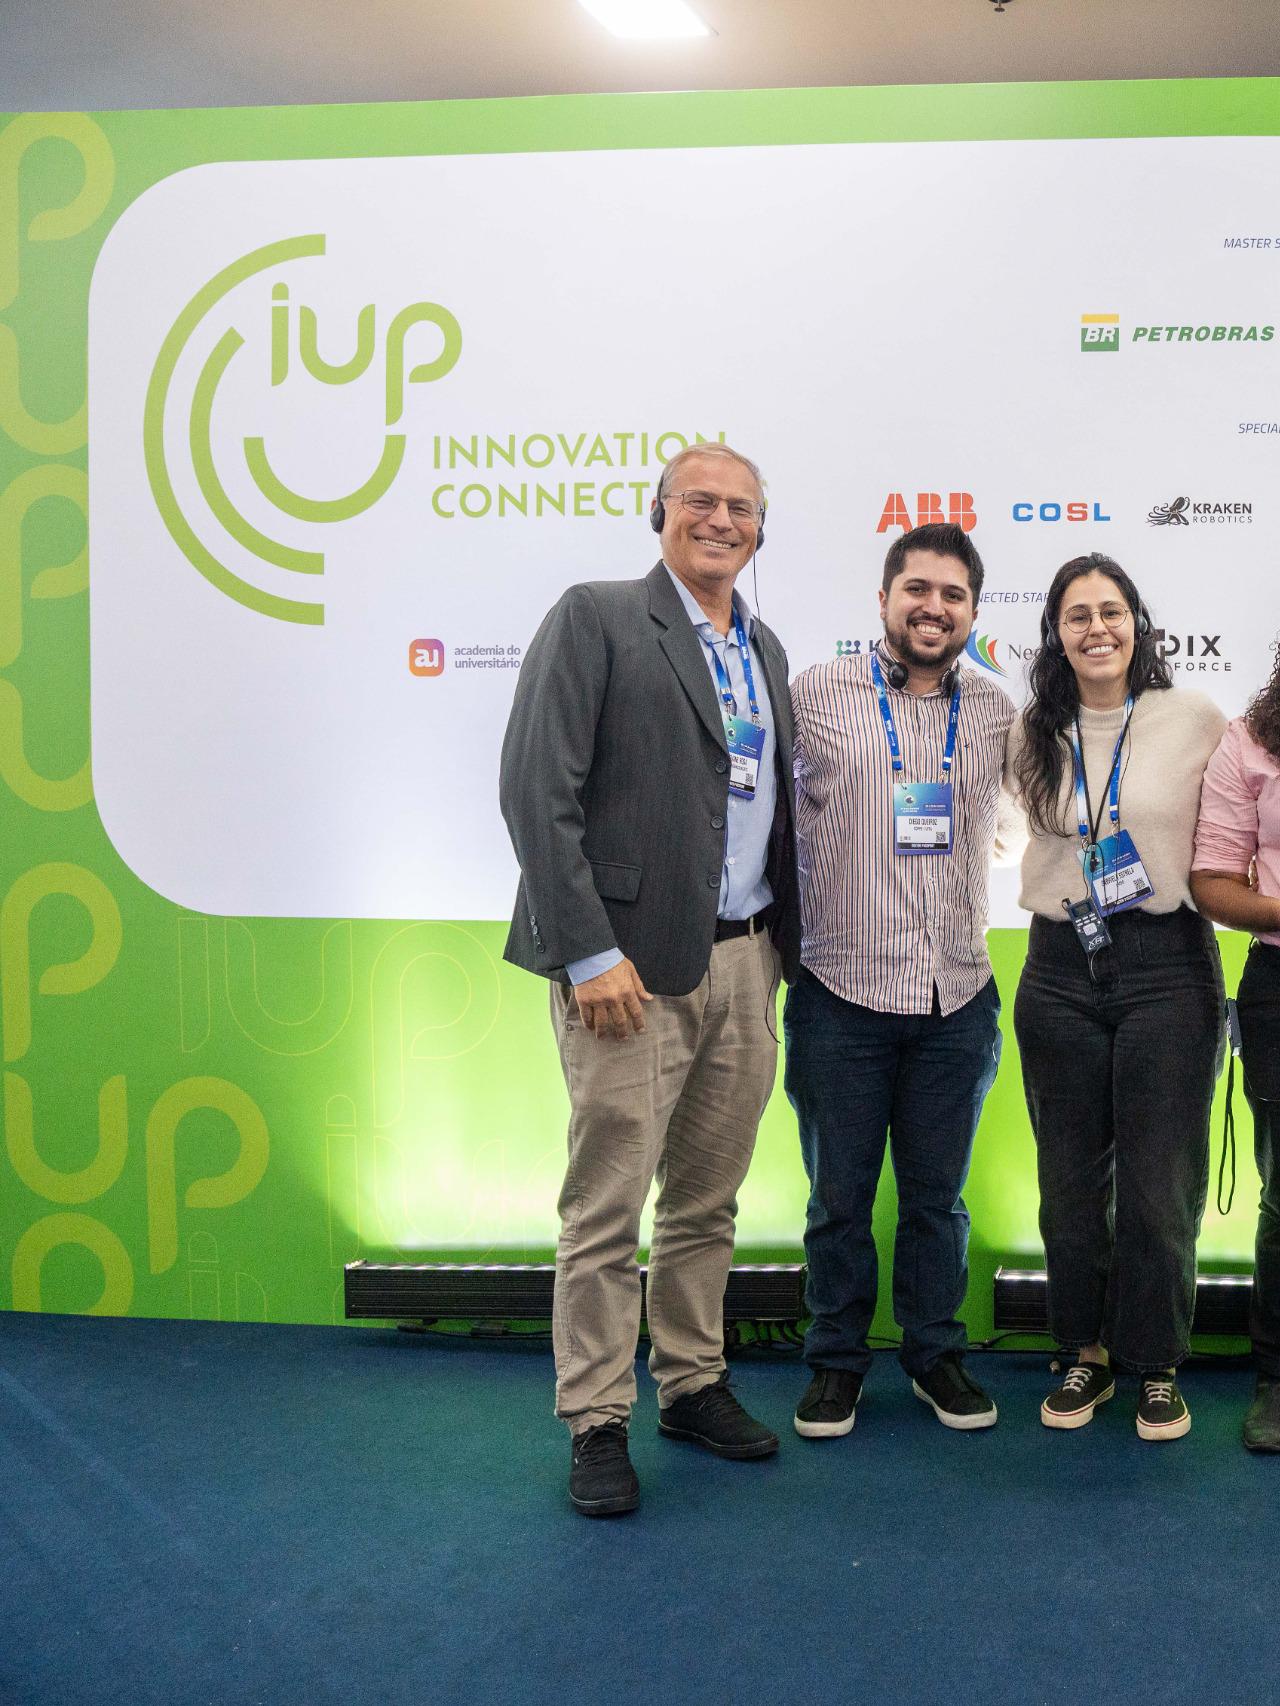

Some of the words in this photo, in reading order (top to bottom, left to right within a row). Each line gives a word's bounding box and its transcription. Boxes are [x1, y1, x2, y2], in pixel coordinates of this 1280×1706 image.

[1223, 238, 1271, 249] MASTER
[1084, 327, 1116, 342] BR
[1132, 326, 1275, 342] PETROBRAS
[432, 481, 769, 518] CONNECT
[876, 493, 977, 533] ABB
[1012, 502, 1111, 522] COSL
[1192, 502, 1252, 514] KRAKEN
[1192, 516, 1253, 524] ROBOTICS
[454, 644, 504, 656] academia
[506, 644, 521, 656] do
[454, 656, 521, 669] universitário
[1174, 662, 1232, 672] FORCE
